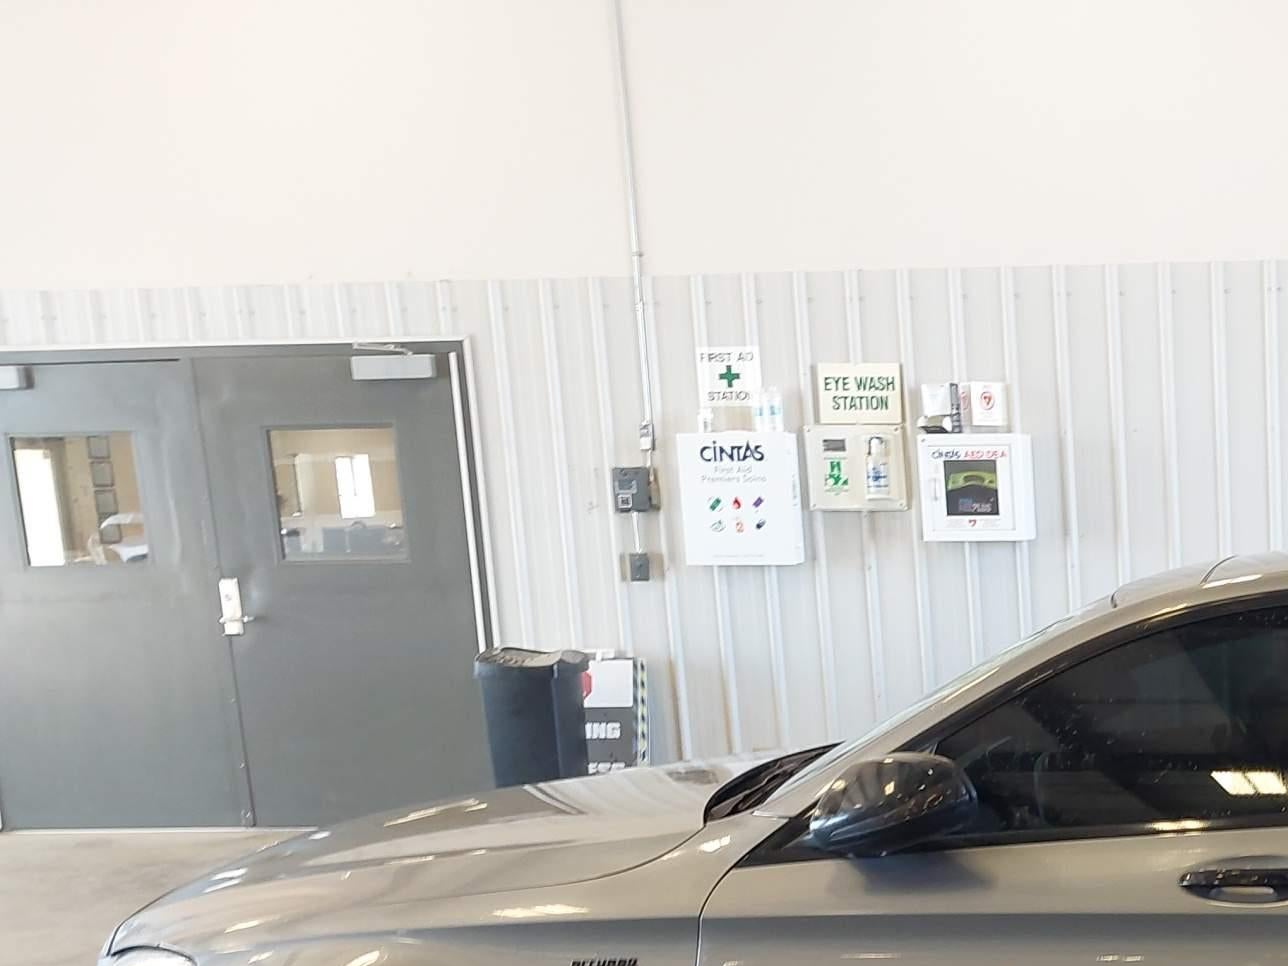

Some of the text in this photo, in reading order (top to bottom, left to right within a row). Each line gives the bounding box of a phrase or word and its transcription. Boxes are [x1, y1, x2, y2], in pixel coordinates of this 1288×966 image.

[824, 376, 896, 392] EYE WASH
[832, 396, 889, 411] STATION
